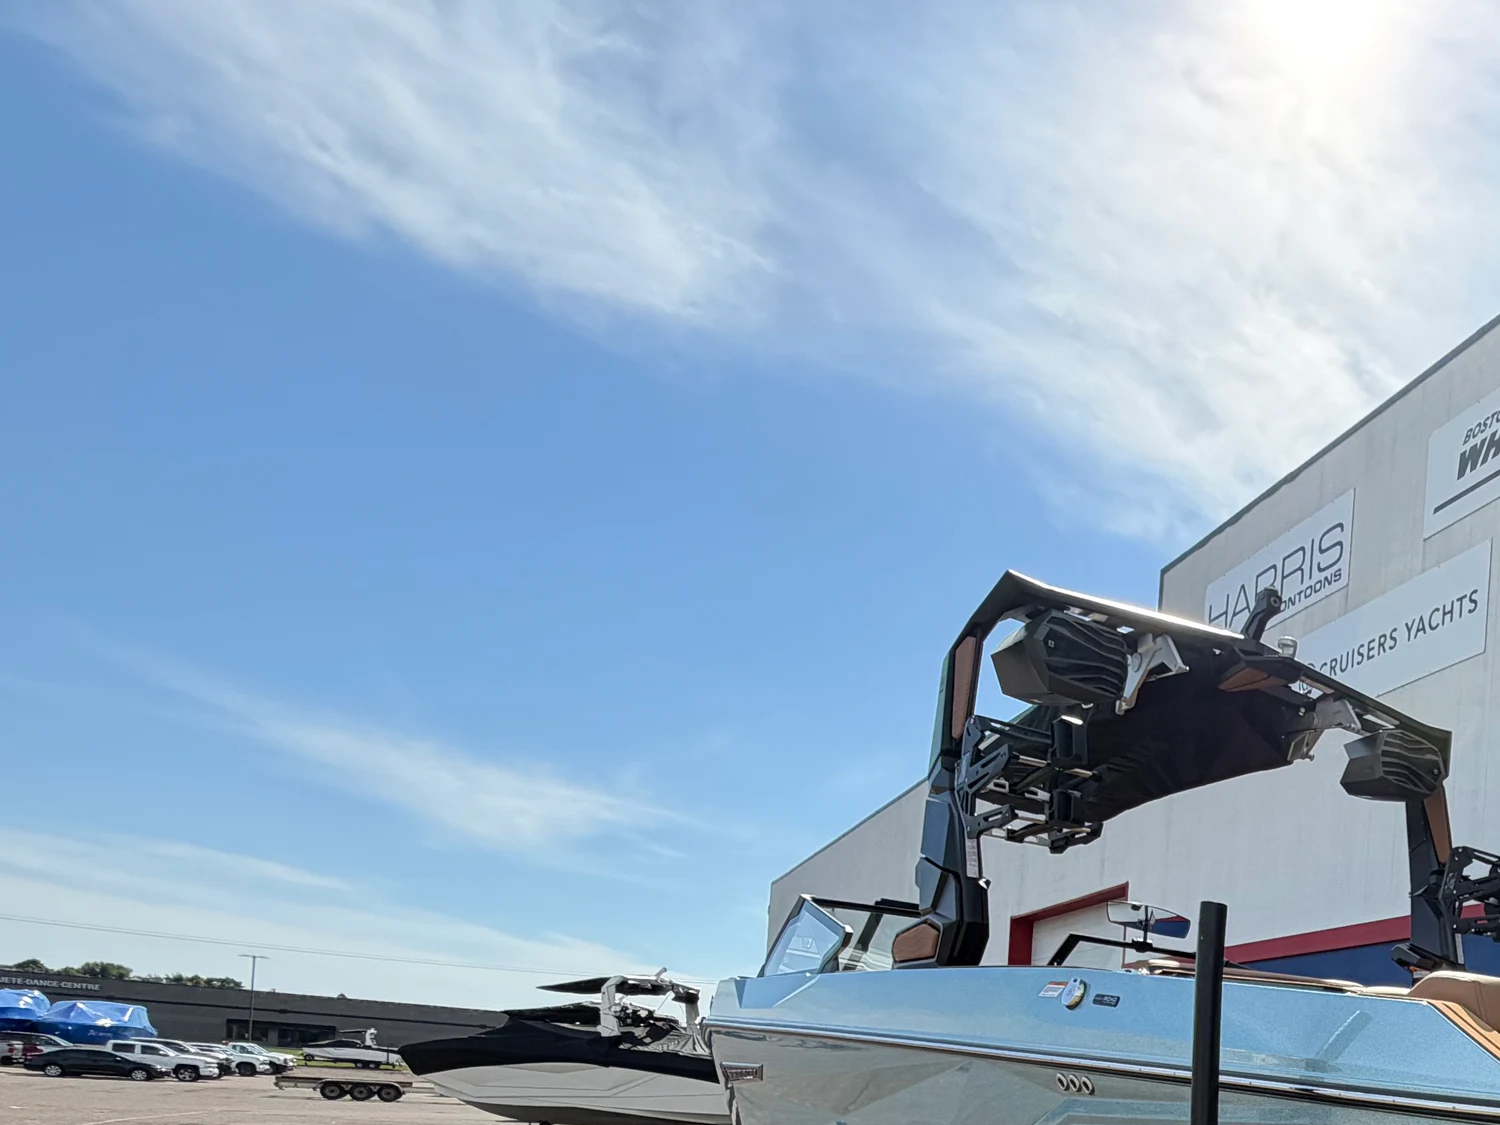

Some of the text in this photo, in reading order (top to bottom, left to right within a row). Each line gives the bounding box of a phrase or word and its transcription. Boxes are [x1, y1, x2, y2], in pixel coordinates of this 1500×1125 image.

[1208, 521, 1345, 629] HARRIS
[1280, 567, 1342, 613] ONTOONS
[1404, 588, 1479, 643] YACHTS
[61, 981, 101, 991] CENTRE
